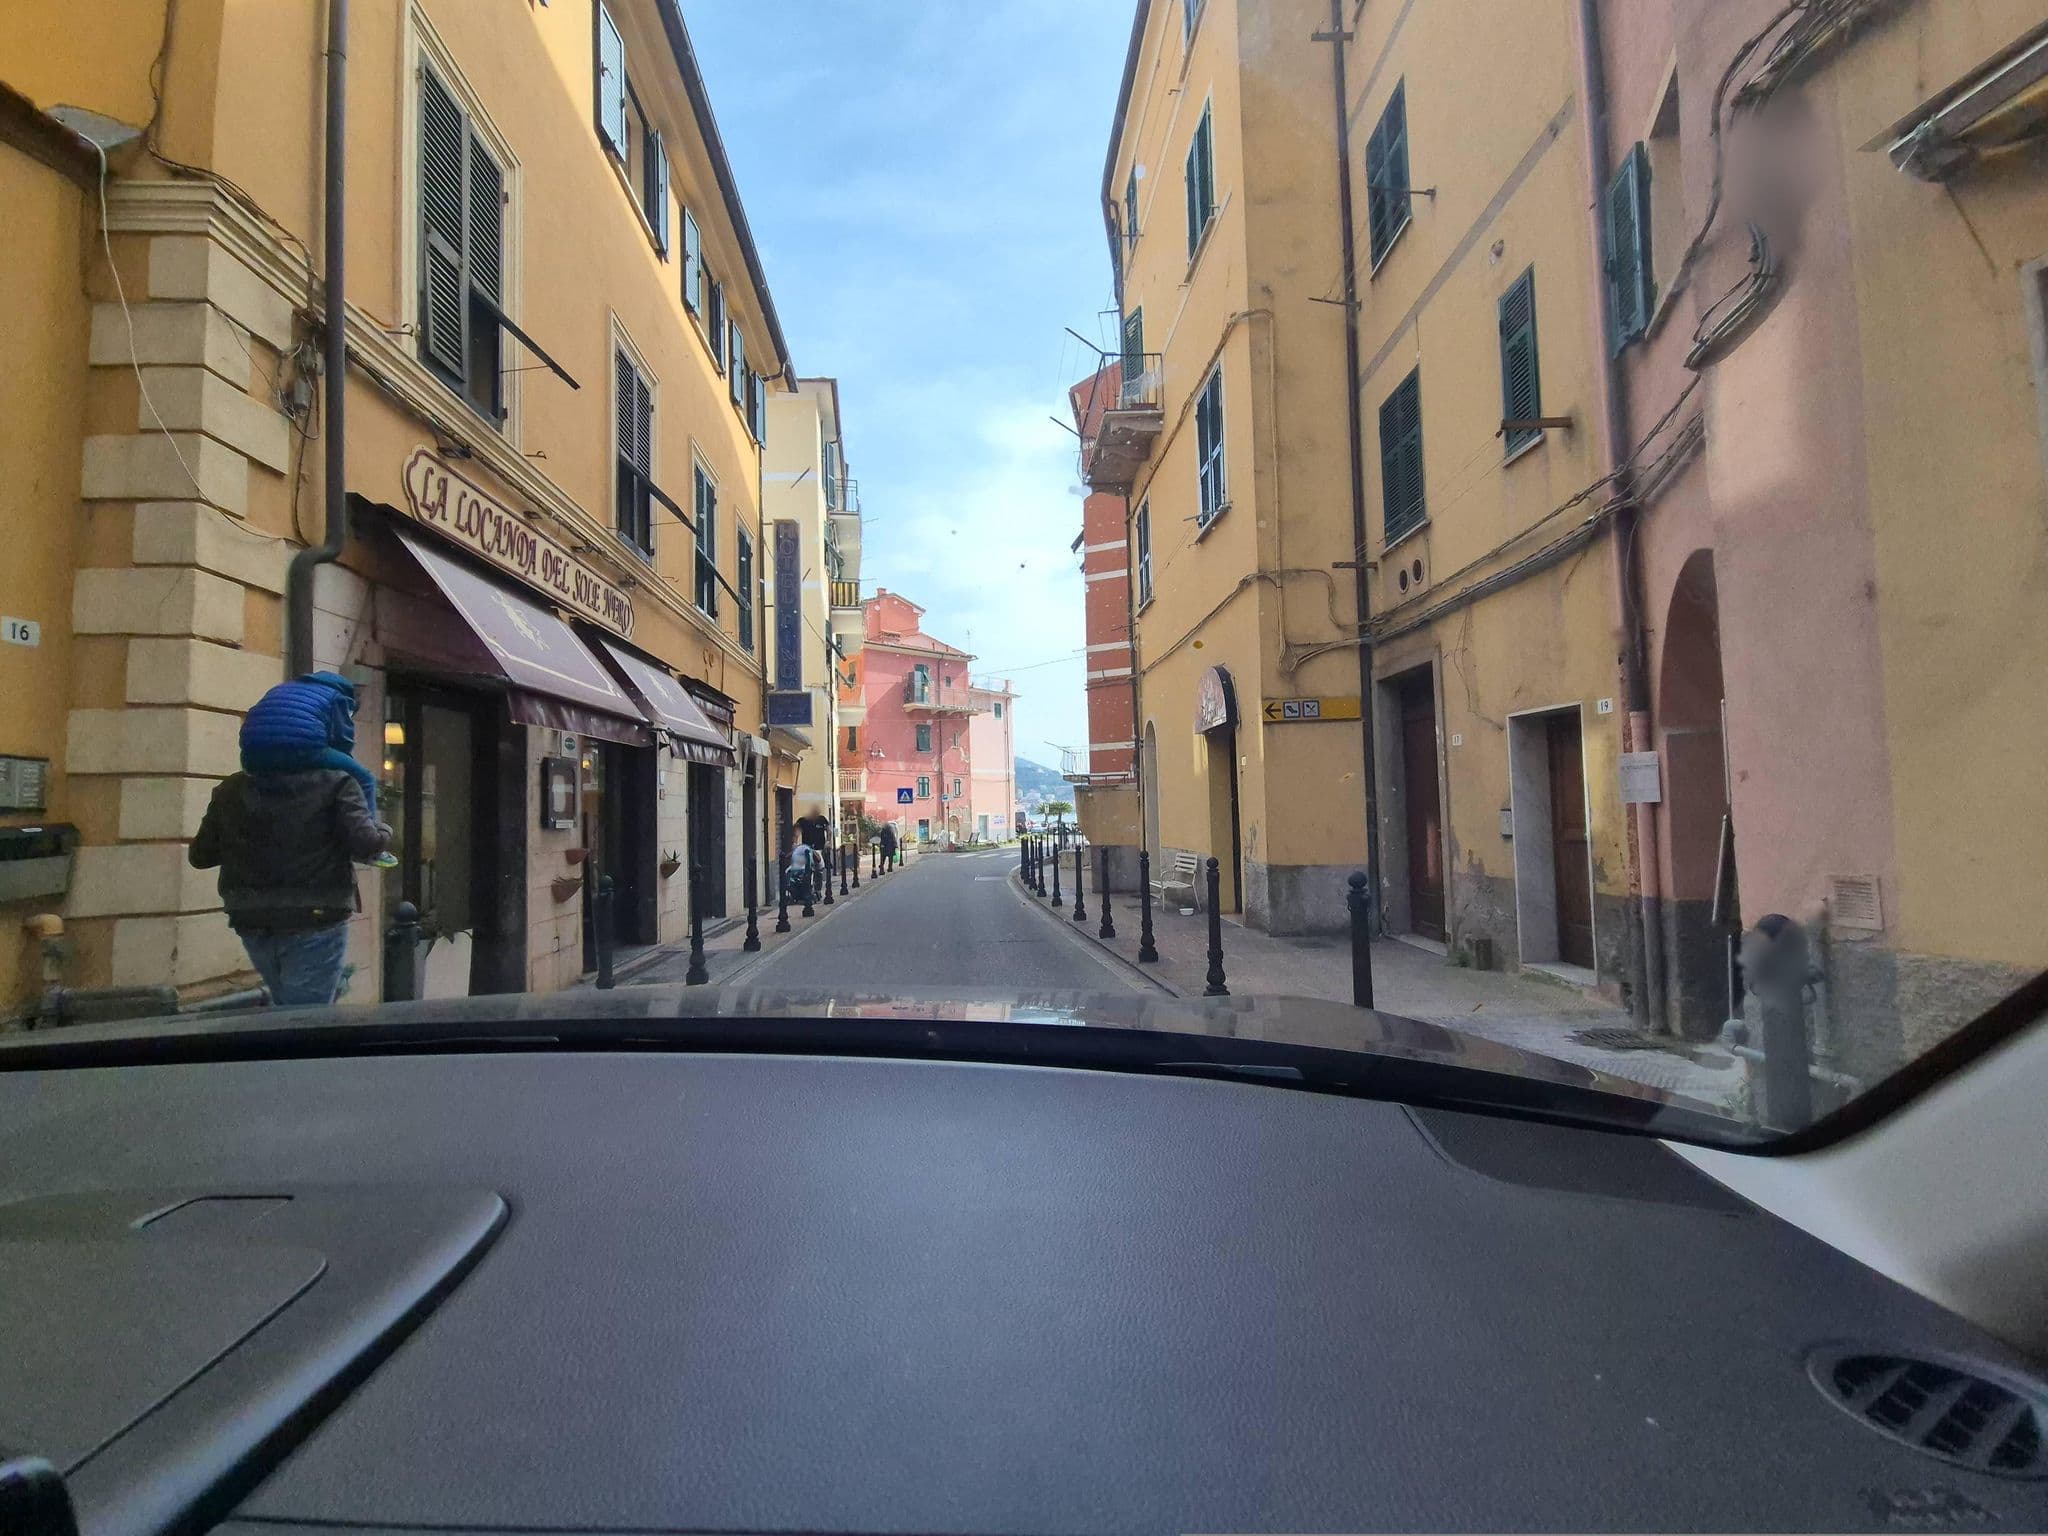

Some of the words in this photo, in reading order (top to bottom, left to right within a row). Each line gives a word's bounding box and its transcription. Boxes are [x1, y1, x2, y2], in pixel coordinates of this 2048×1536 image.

[420, 467, 448, 521] LA
[454, 490, 537, 576] LOCANDA
[542, 548, 570, 594] DEL
[572, 568, 601, 613] SOLE
[602, 587, 631, 634] NERO
[779, 523, 795, 604] HOTEL
[11, 622, 29, 641] 16
[1600, 700, 1609, 712] 19
